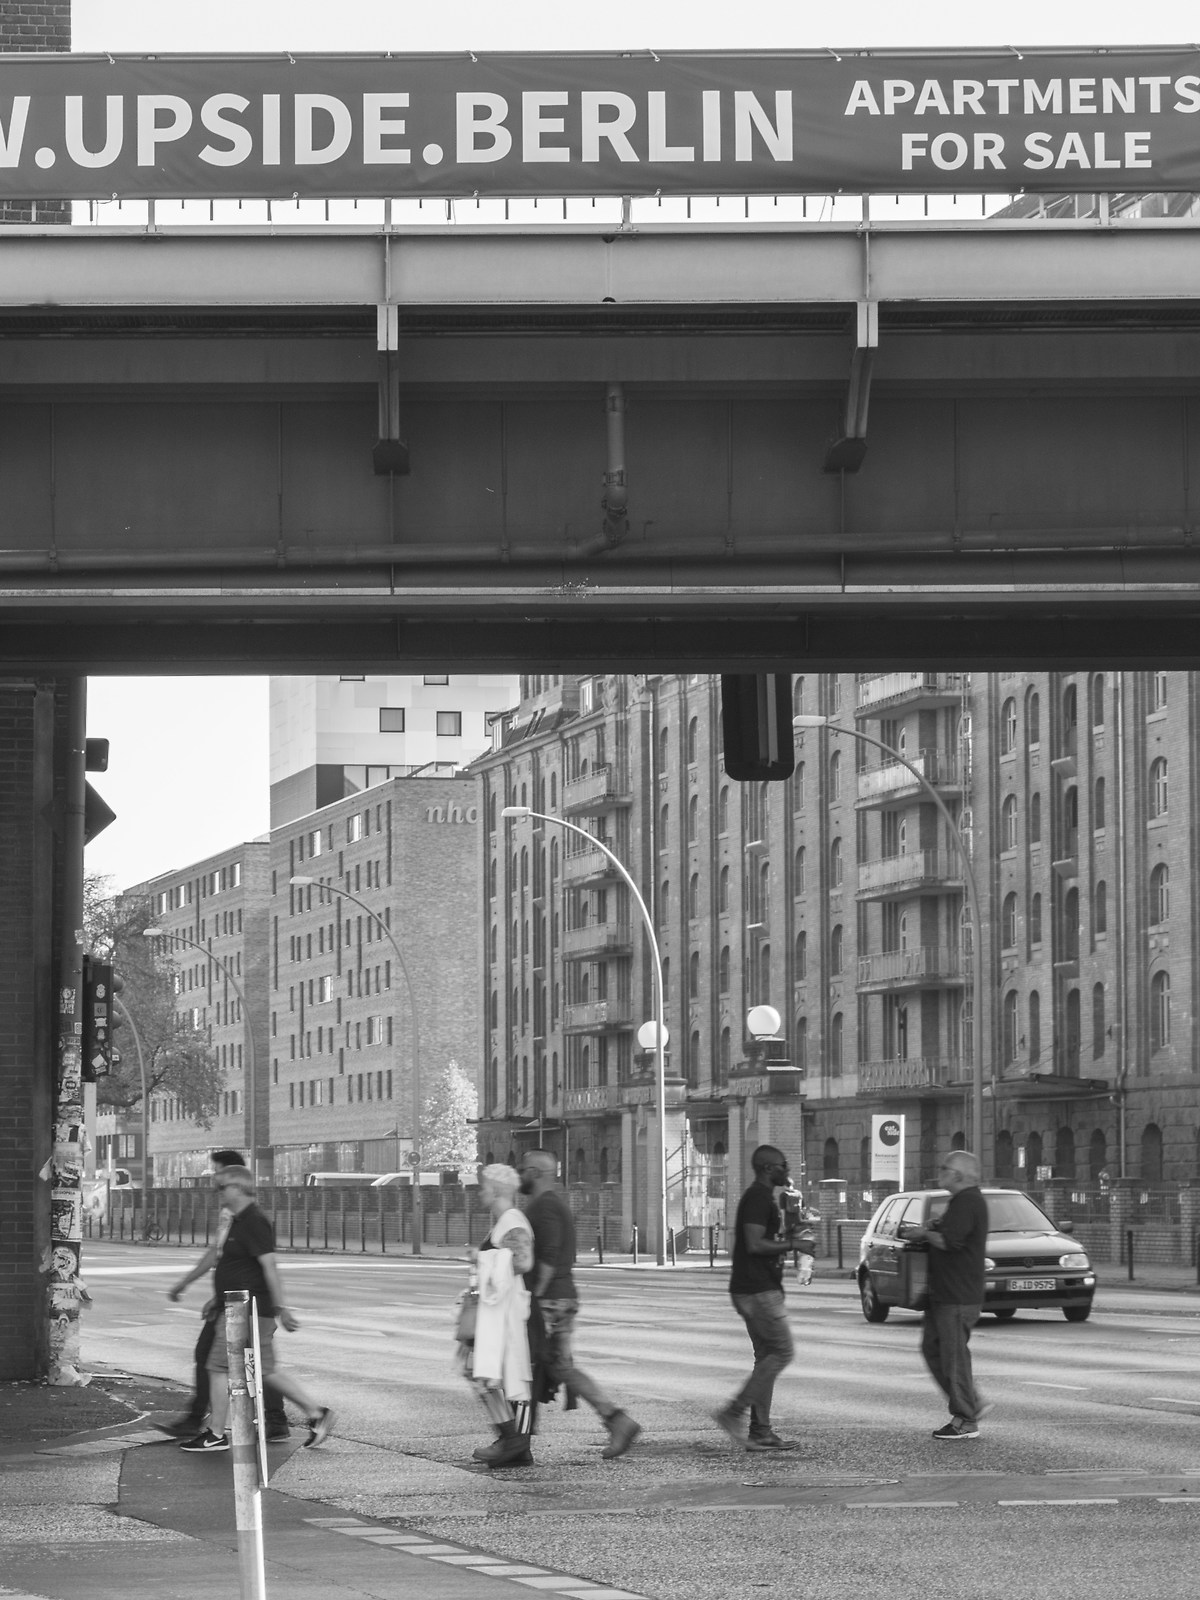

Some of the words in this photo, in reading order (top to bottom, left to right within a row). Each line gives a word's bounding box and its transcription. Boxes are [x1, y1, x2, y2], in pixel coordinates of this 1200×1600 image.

[844, 75, 1200, 116] APARTMENTS
[902, 132, 1007, 170] FOR
[1023, 131, 1152, 170] SALE
